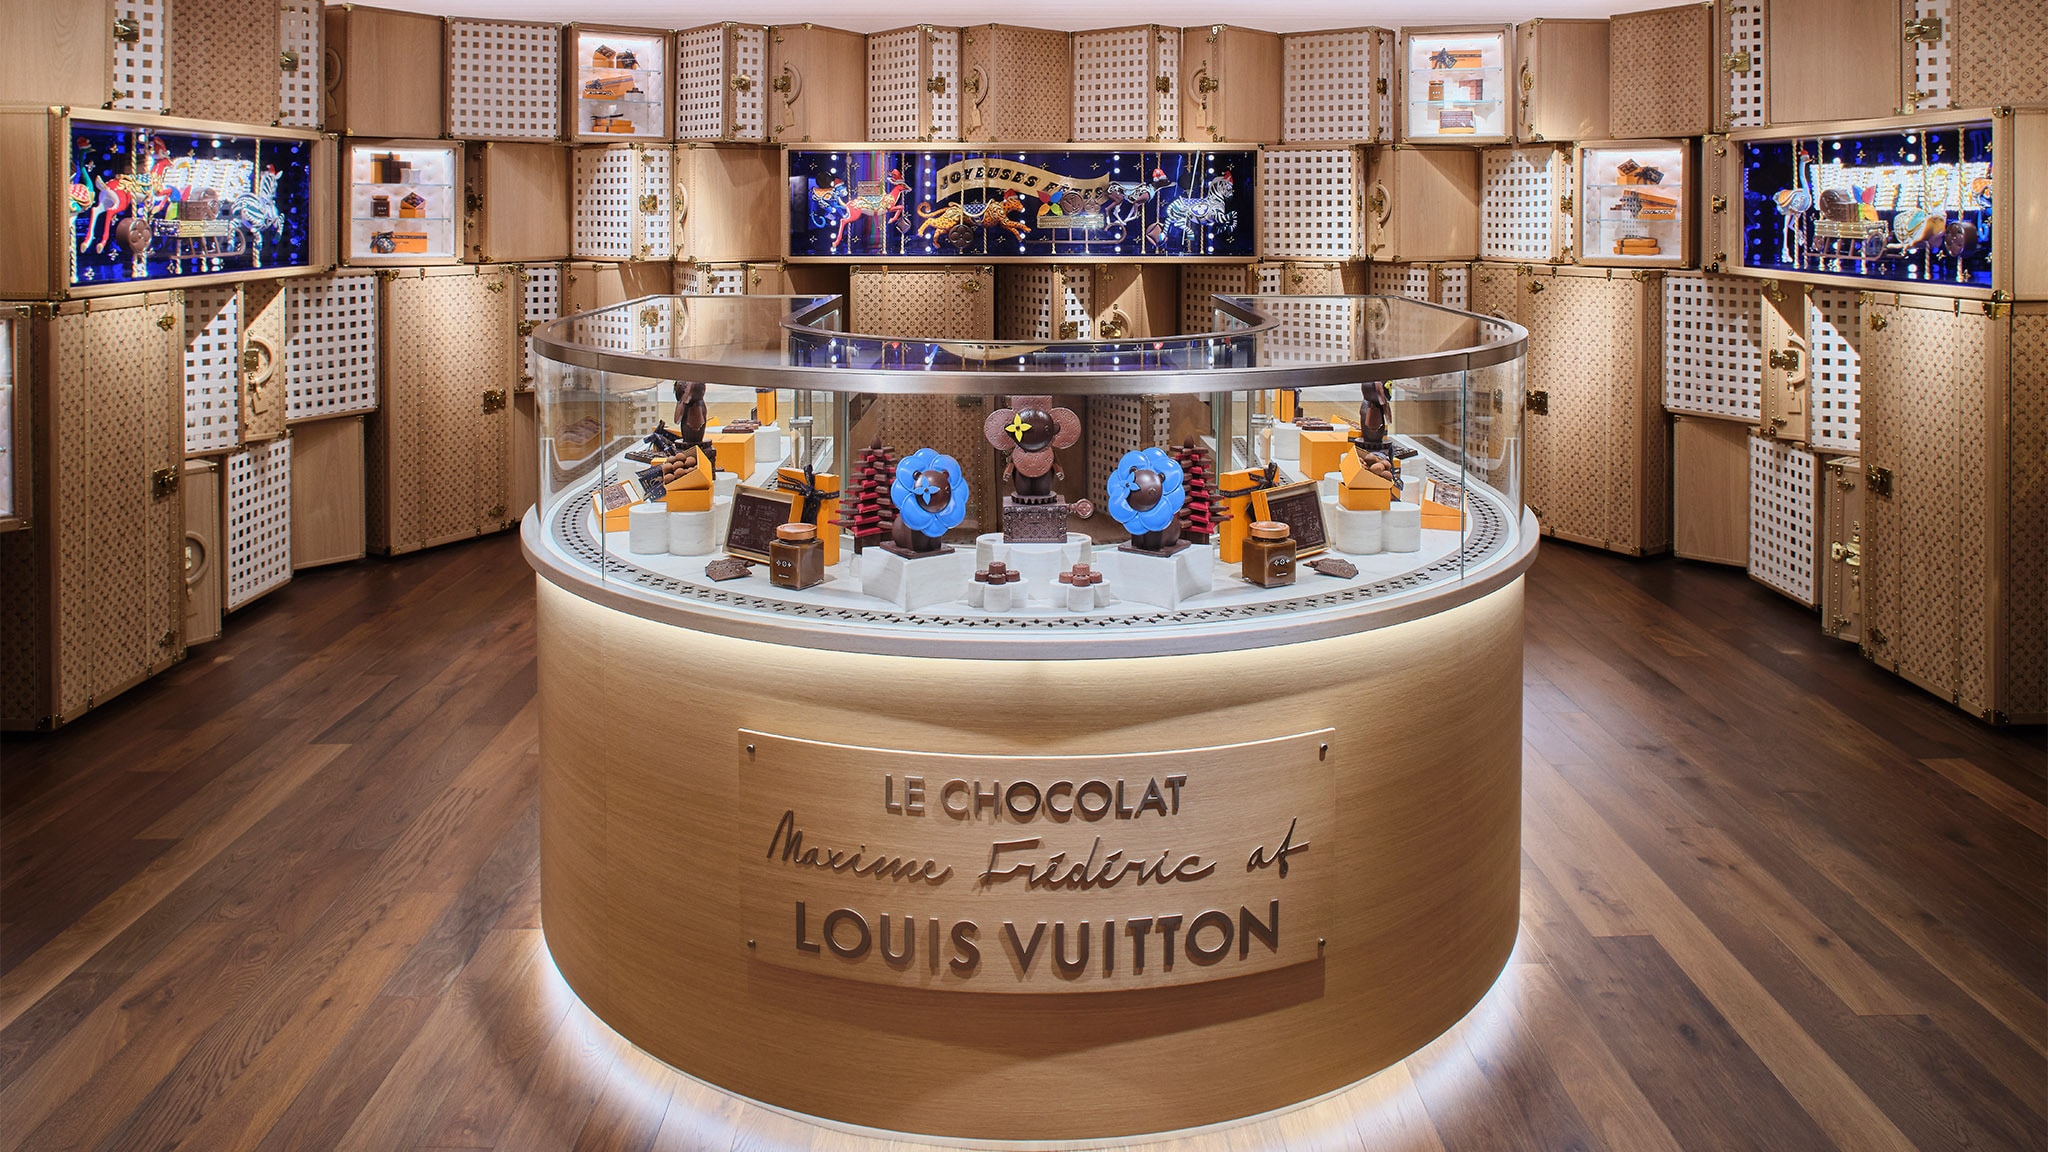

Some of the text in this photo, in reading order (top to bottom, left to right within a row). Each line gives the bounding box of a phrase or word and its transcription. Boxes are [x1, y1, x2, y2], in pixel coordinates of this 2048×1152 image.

[940, 166, 1039, 190] JOYEUSES
[885, 773, 1187, 817] LE CHOCOLAT
[766, 809, 952, 880] Maxime
[796, 898, 1280, 976] LOUIS VUITTON
